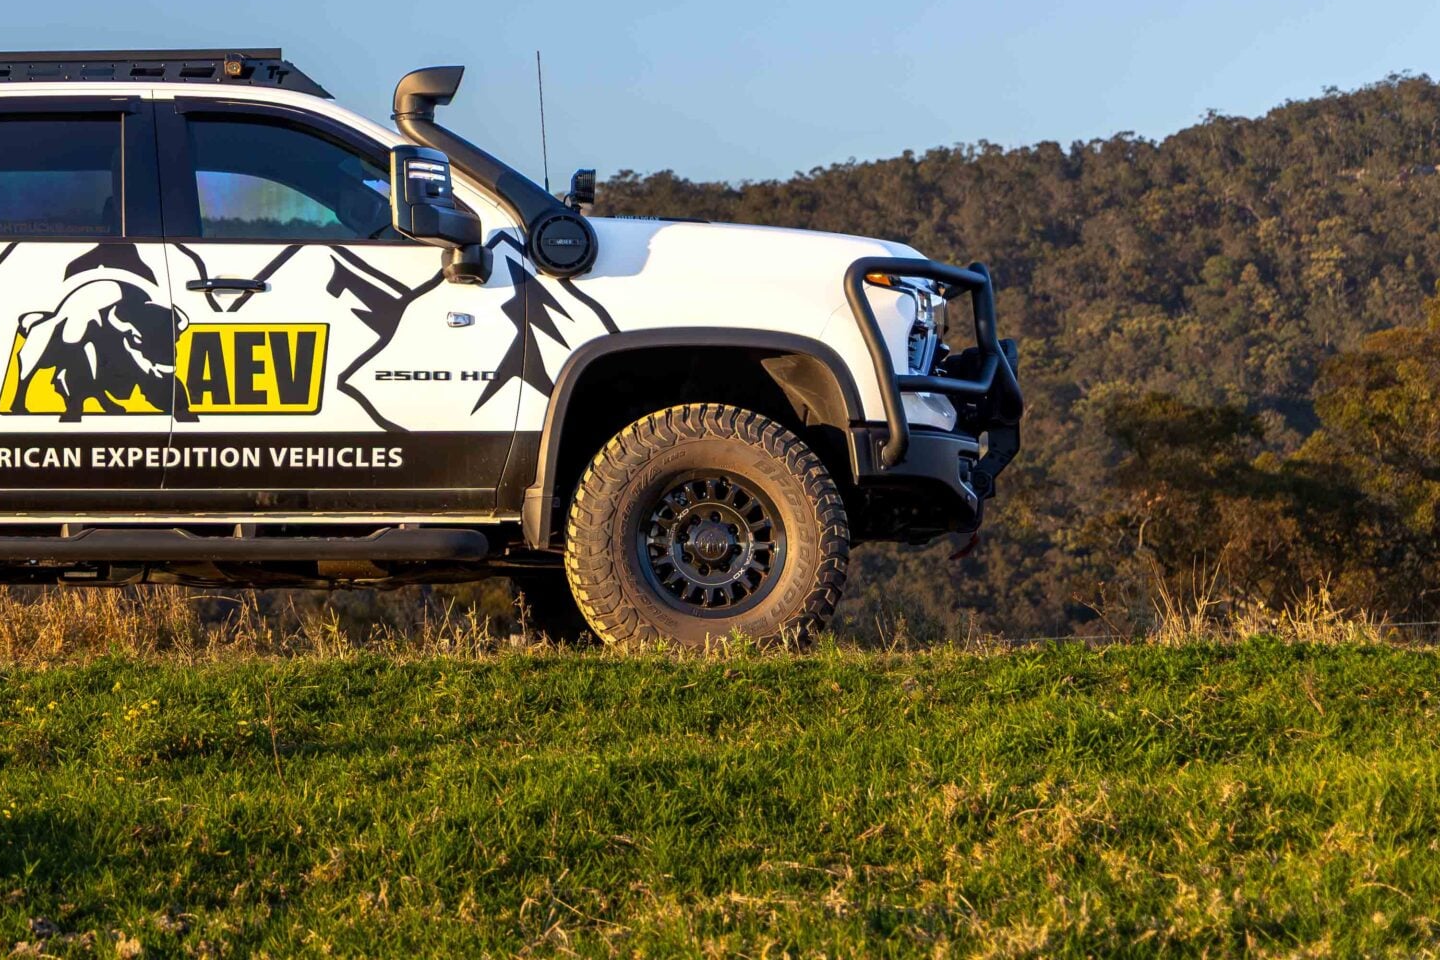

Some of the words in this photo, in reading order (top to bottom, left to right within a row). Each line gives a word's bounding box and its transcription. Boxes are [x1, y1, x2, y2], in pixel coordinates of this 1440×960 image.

[186, 331, 317, 405] AEV
[375, 370, 451, 381] 2500
[461, 370, 500, 381] HD
[92, 442, 260, 468] EXPEDITION
[269, 442, 403, 468] VEHICLES
